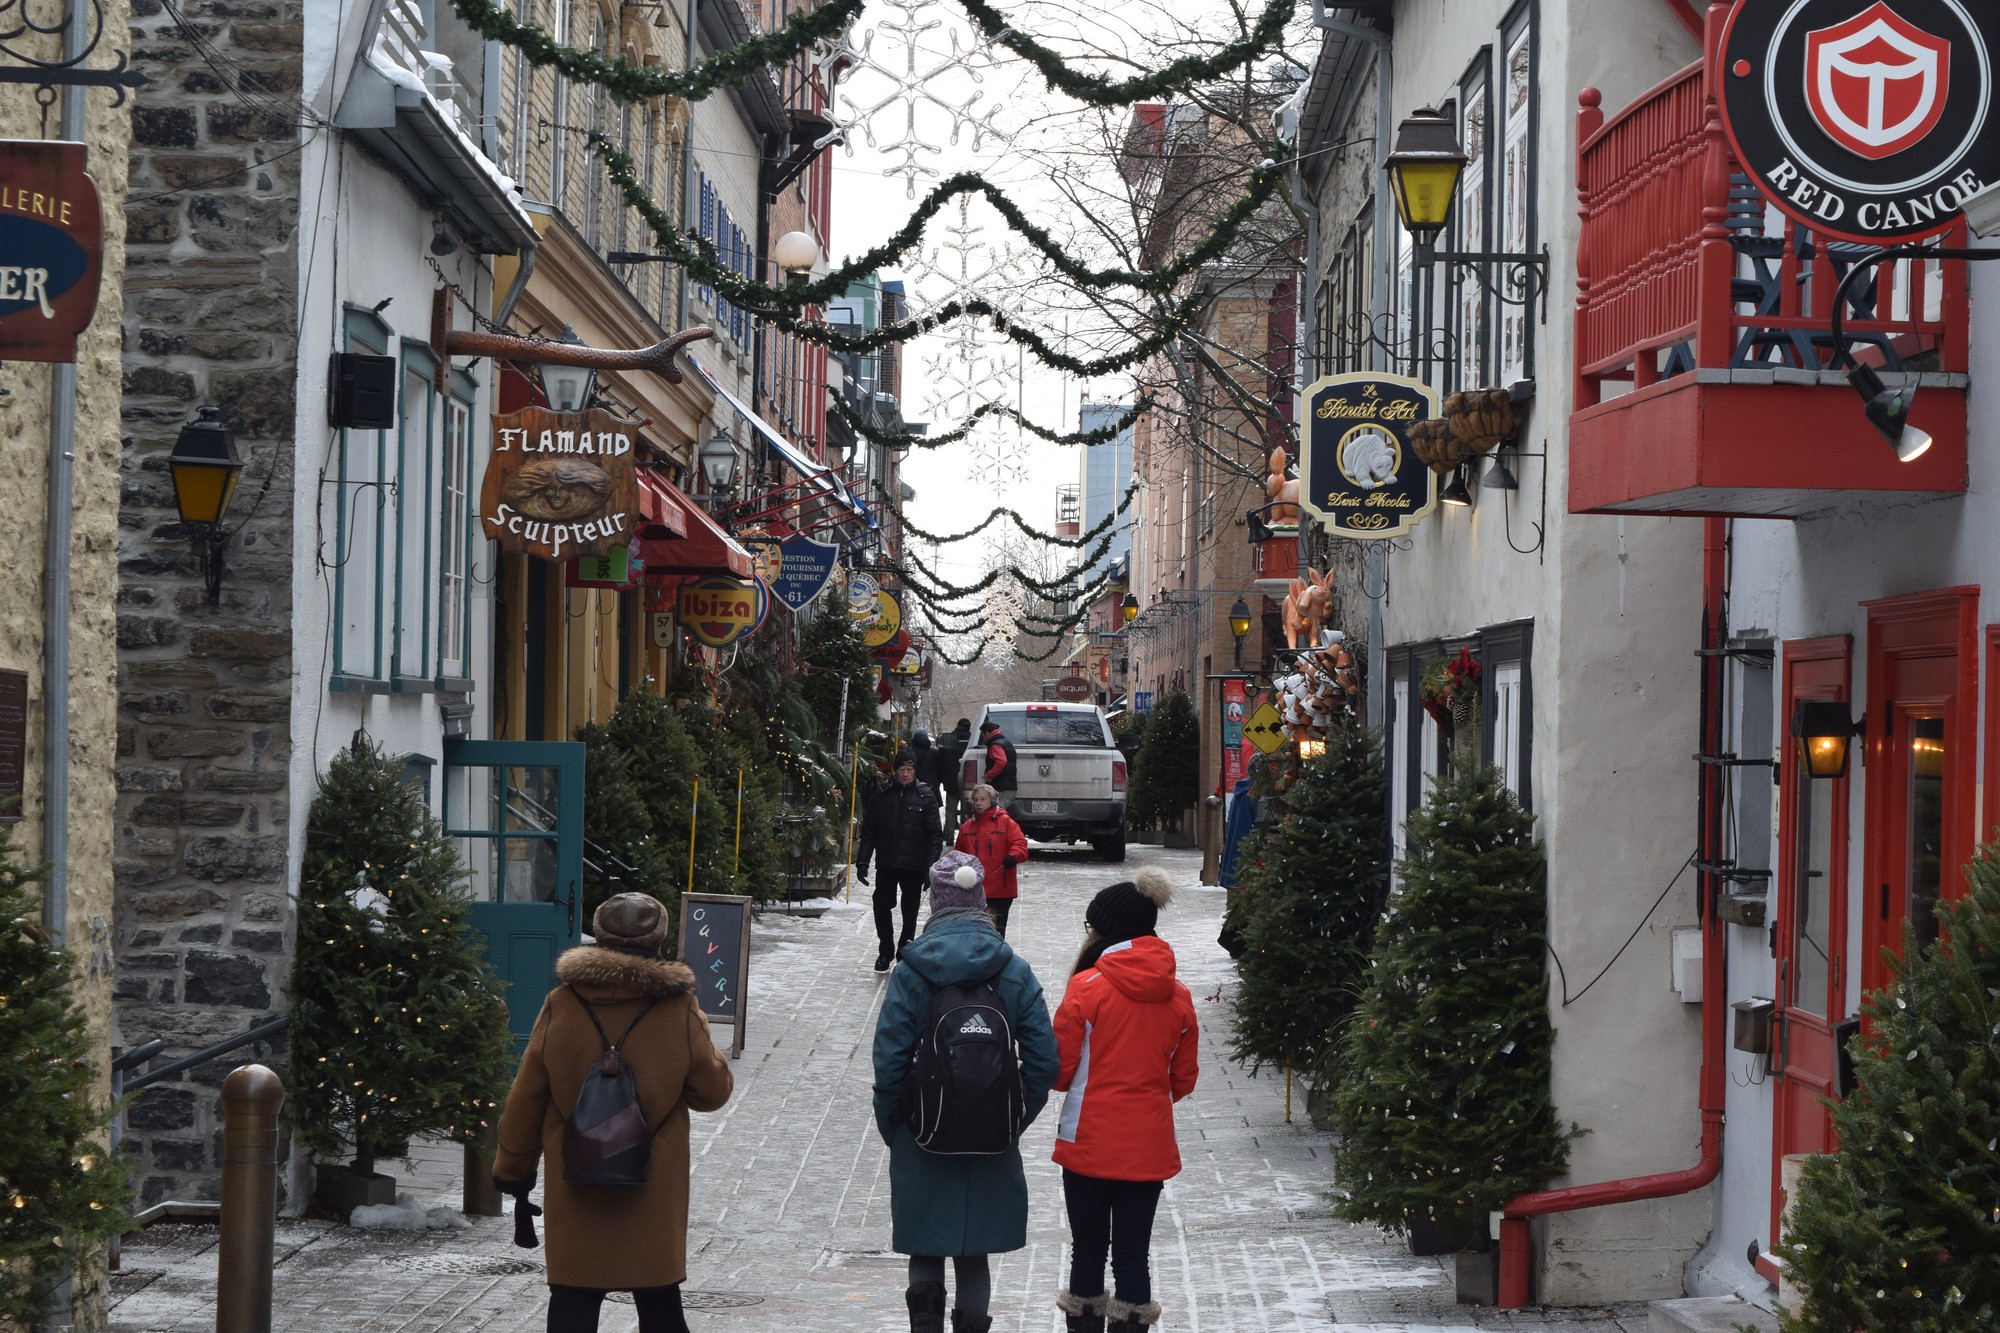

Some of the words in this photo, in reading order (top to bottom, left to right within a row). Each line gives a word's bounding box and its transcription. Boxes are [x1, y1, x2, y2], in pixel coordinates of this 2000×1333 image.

[1766, 157, 1845, 221] RED
[1857, 168, 1986, 231] CANOE
[0, 265, 56, 319] ER
[1362, 383, 1379, 399] La
[1316, 397, 1383, 420] Boutik
[1379, 399, 1420, 421] Art
[496, 427, 631, 457] FLAMAND
[1327, 491, 1361, 508] Denis
[1364, 491, 1412, 508] Nicolas
[486, 503, 626, 558] Sculpteur
[782, 564, 826, 573] TOURISME
[786, 572, 821, 582] QUÉBEC
[684, 593, 750, 618] Ibiza
[657, 616, 670, 627] 57
[1060, 685, 1087, 693] aqua
[960, 1025, 992, 1035] adidas
